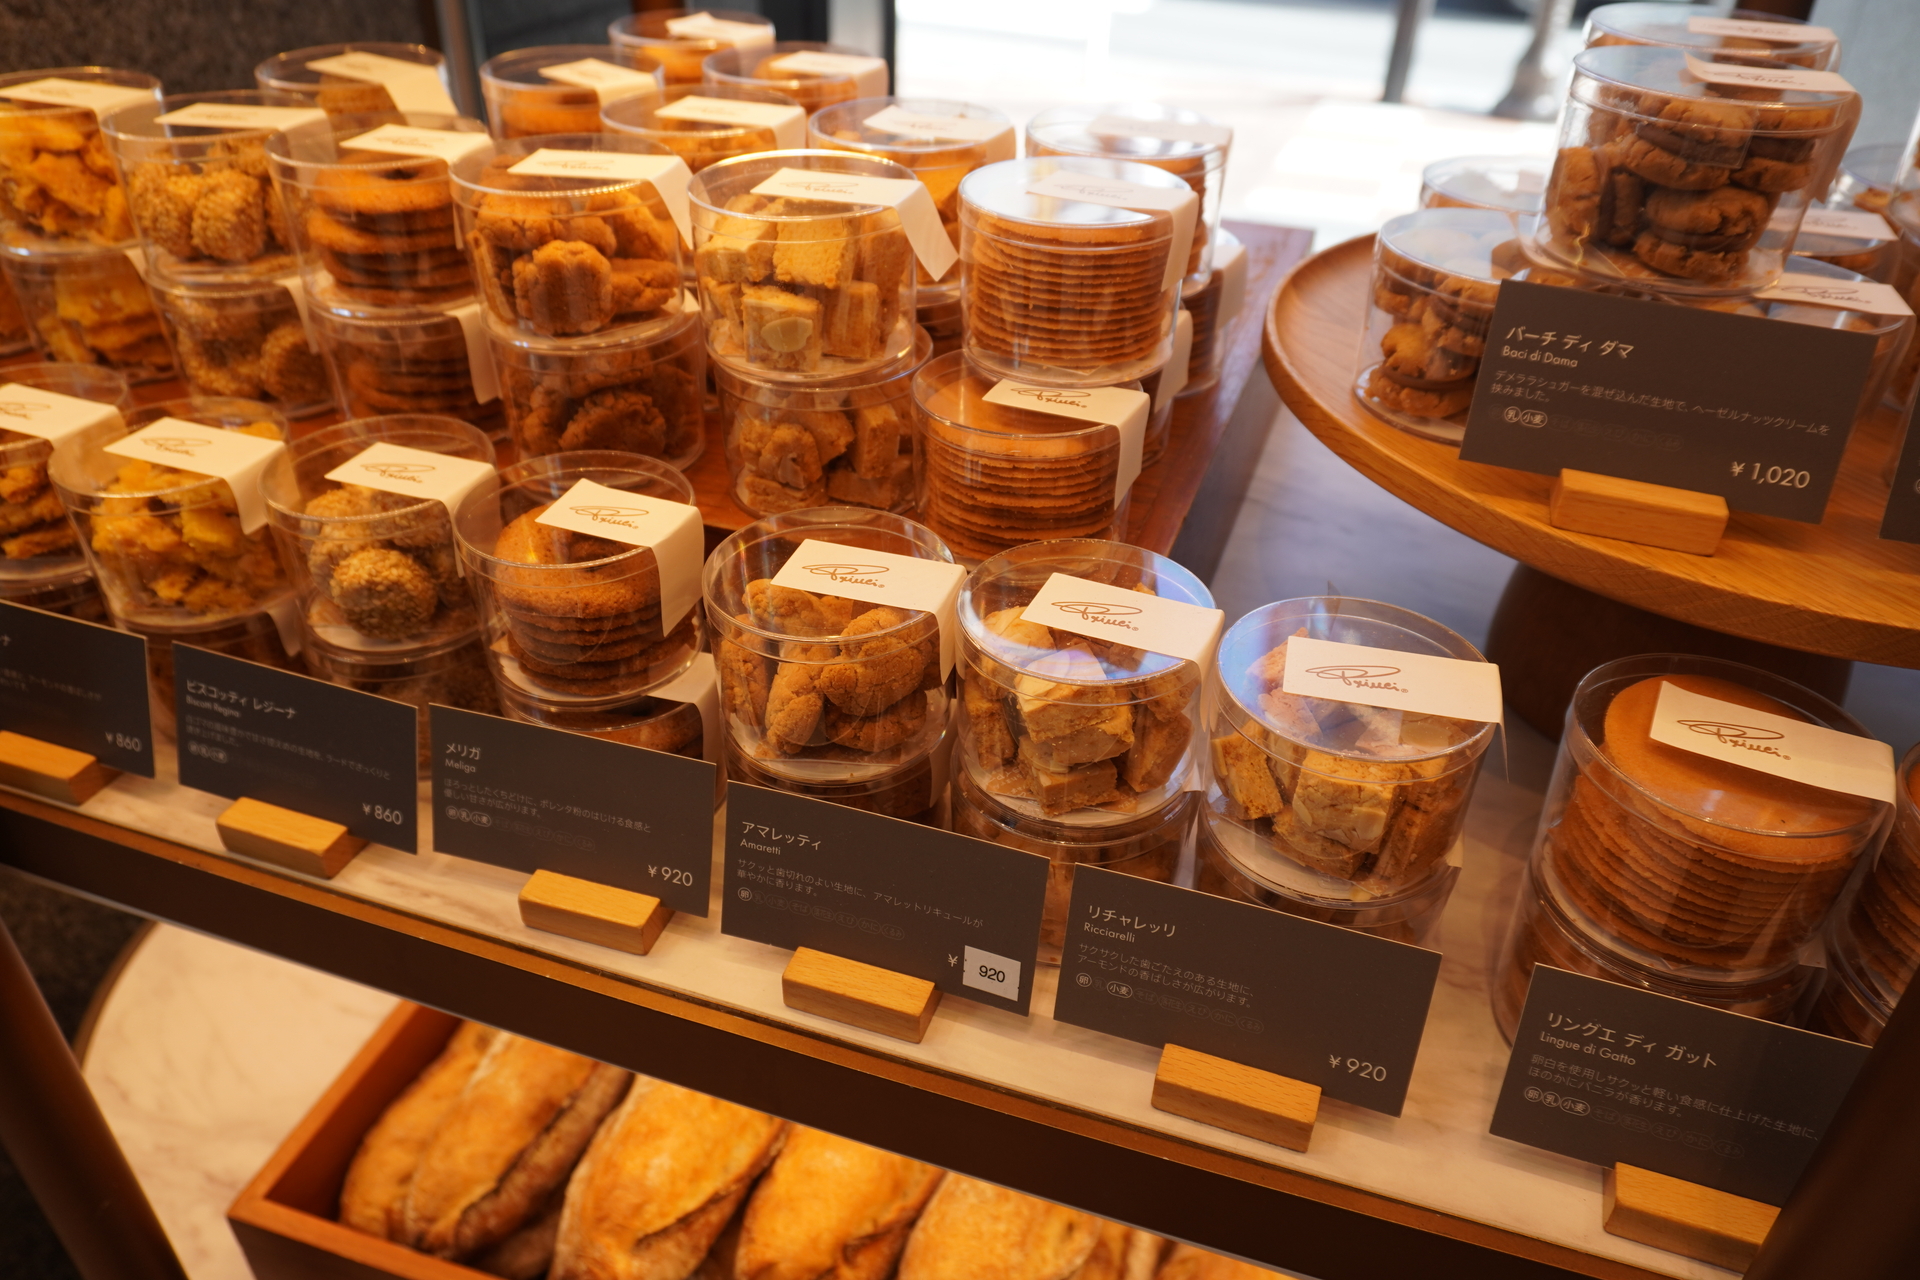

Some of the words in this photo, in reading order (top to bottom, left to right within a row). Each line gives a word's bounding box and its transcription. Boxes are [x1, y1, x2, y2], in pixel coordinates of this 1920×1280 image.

[1504, 325, 1558, 346] バーチ
[1560, 333, 1593, 353] ディ
[1598, 340, 1635, 359] ダマ
[1502, 346, 1528, 360] Baci
[1530, 350, 1542, 362] di
[1544, 352, 1578, 368] Dama
[1506, 408, 1519, 421] 乳
[1522, 411, 1547, 426] 小麦
[186, 679, 247, 707] ビスコッティ
[252, 697, 298, 719] レジーナ
[213, 702, 241, 718] Regina
[445, 743, 481, 761] メリガ
[444, 758, 476, 773] Meliga
[444, 788, 541, 818] 優しい甘さが広がります。
[472, 813, 490, 825] 小麦
[740, 838, 781, 855] Amaretti
[741, 821, 822, 851] アマレッティ
[737, 869, 818, 897] 華やかに香ります。
[738, 858, 984, 928] サクッと歯切れのよい生地に、アマレットリキュールが
[739, 888, 750, 900] 卵
[1083, 922, 1136, 943] Ricciarelli
[1088, 905, 1176, 938] リチャレッリ
[979, 965, 1005, 983] 920
[1077, 954, 1252, 1009] アーモンドの香ばしさが広がります。
[1078, 942, 1254, 997] サクサクした歯ごたえのある生地に、
[1078, 974, 1090, 986] 卵
[1108, 983, 1131, 997] 小麦
[1540, 1031, 1581, 1052] Lingue
[1583, 1042, 1596, 1057] di
[1599, 1045, 1636, 1066] Gatto
[1547, 1012, 1616, 1043] リングエ
[1623, 1032, 1657, 1054] ディ
[1665, 1044, 1717, 1069] ガット
[1525, 1088, 1541, 1101] 卵
[1543, 1093, 1558, 1106] 乳
[1561, 1098, 1588, 1113] 小麦
[1529, 1066, 1683, 1118] ほのかにバニラが香ります。
